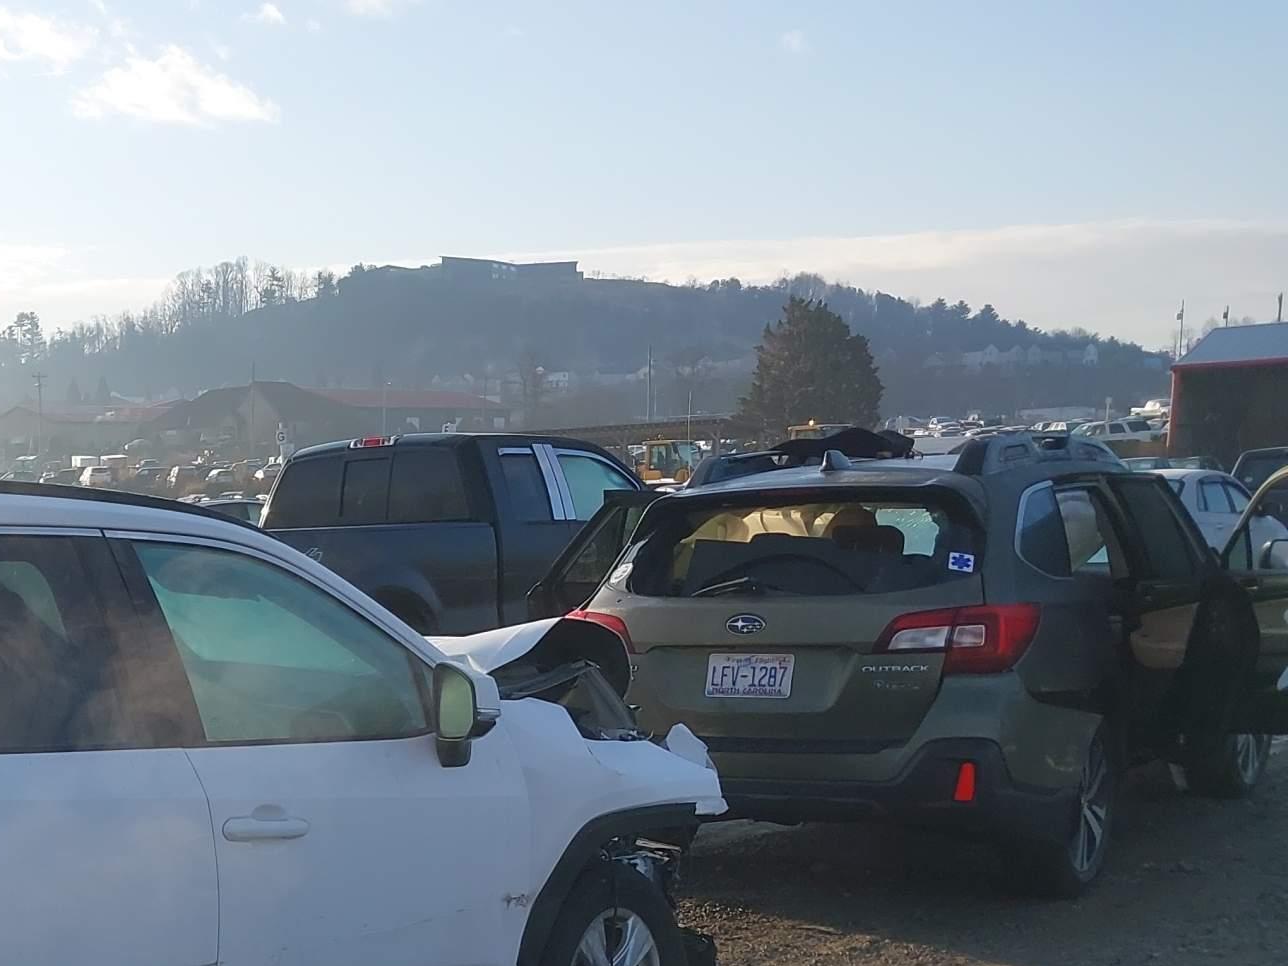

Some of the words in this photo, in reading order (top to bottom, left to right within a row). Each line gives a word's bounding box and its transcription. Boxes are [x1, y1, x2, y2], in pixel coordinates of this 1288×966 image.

[277, 431, 286, 442] G
[711, 665, 788, 687] LFV-1287
[712, 687, 740, 695] NORTH
[742, 687, 782, 695] CAROLINA
